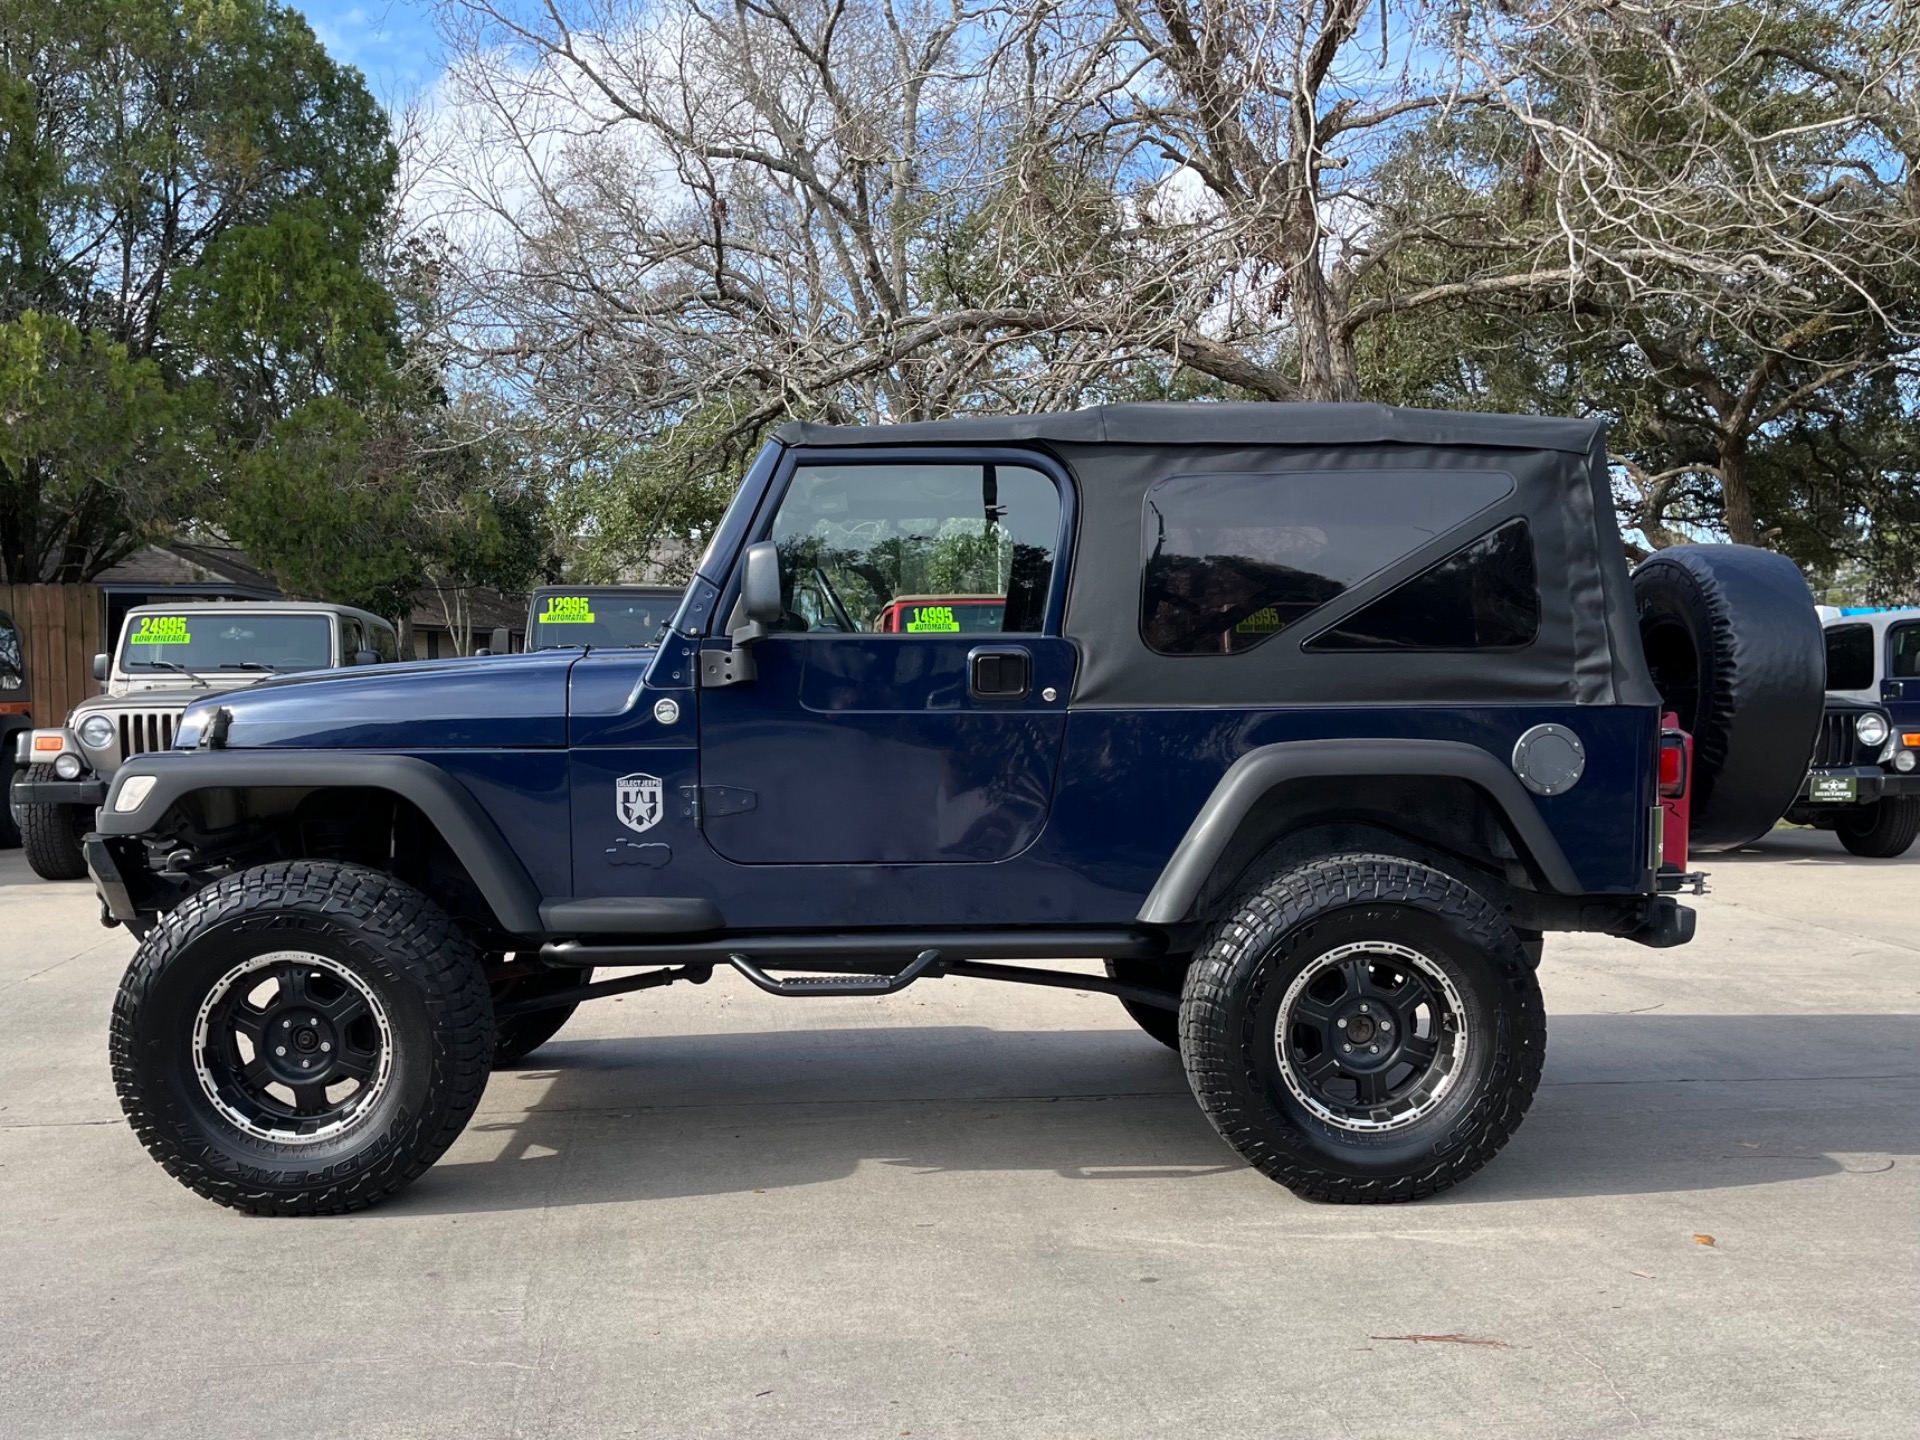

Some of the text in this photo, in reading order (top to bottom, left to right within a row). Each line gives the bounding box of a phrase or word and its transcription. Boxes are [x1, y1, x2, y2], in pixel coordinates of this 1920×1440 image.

[547, 596, 589, 614] 12995
[913, 606, 954, 623] 14995
[140, 616, 187, 634] 24995
[915, 623, 953, 631] AUTOMATIC
[134, 634, 187, 642] LOW MILEAGE
